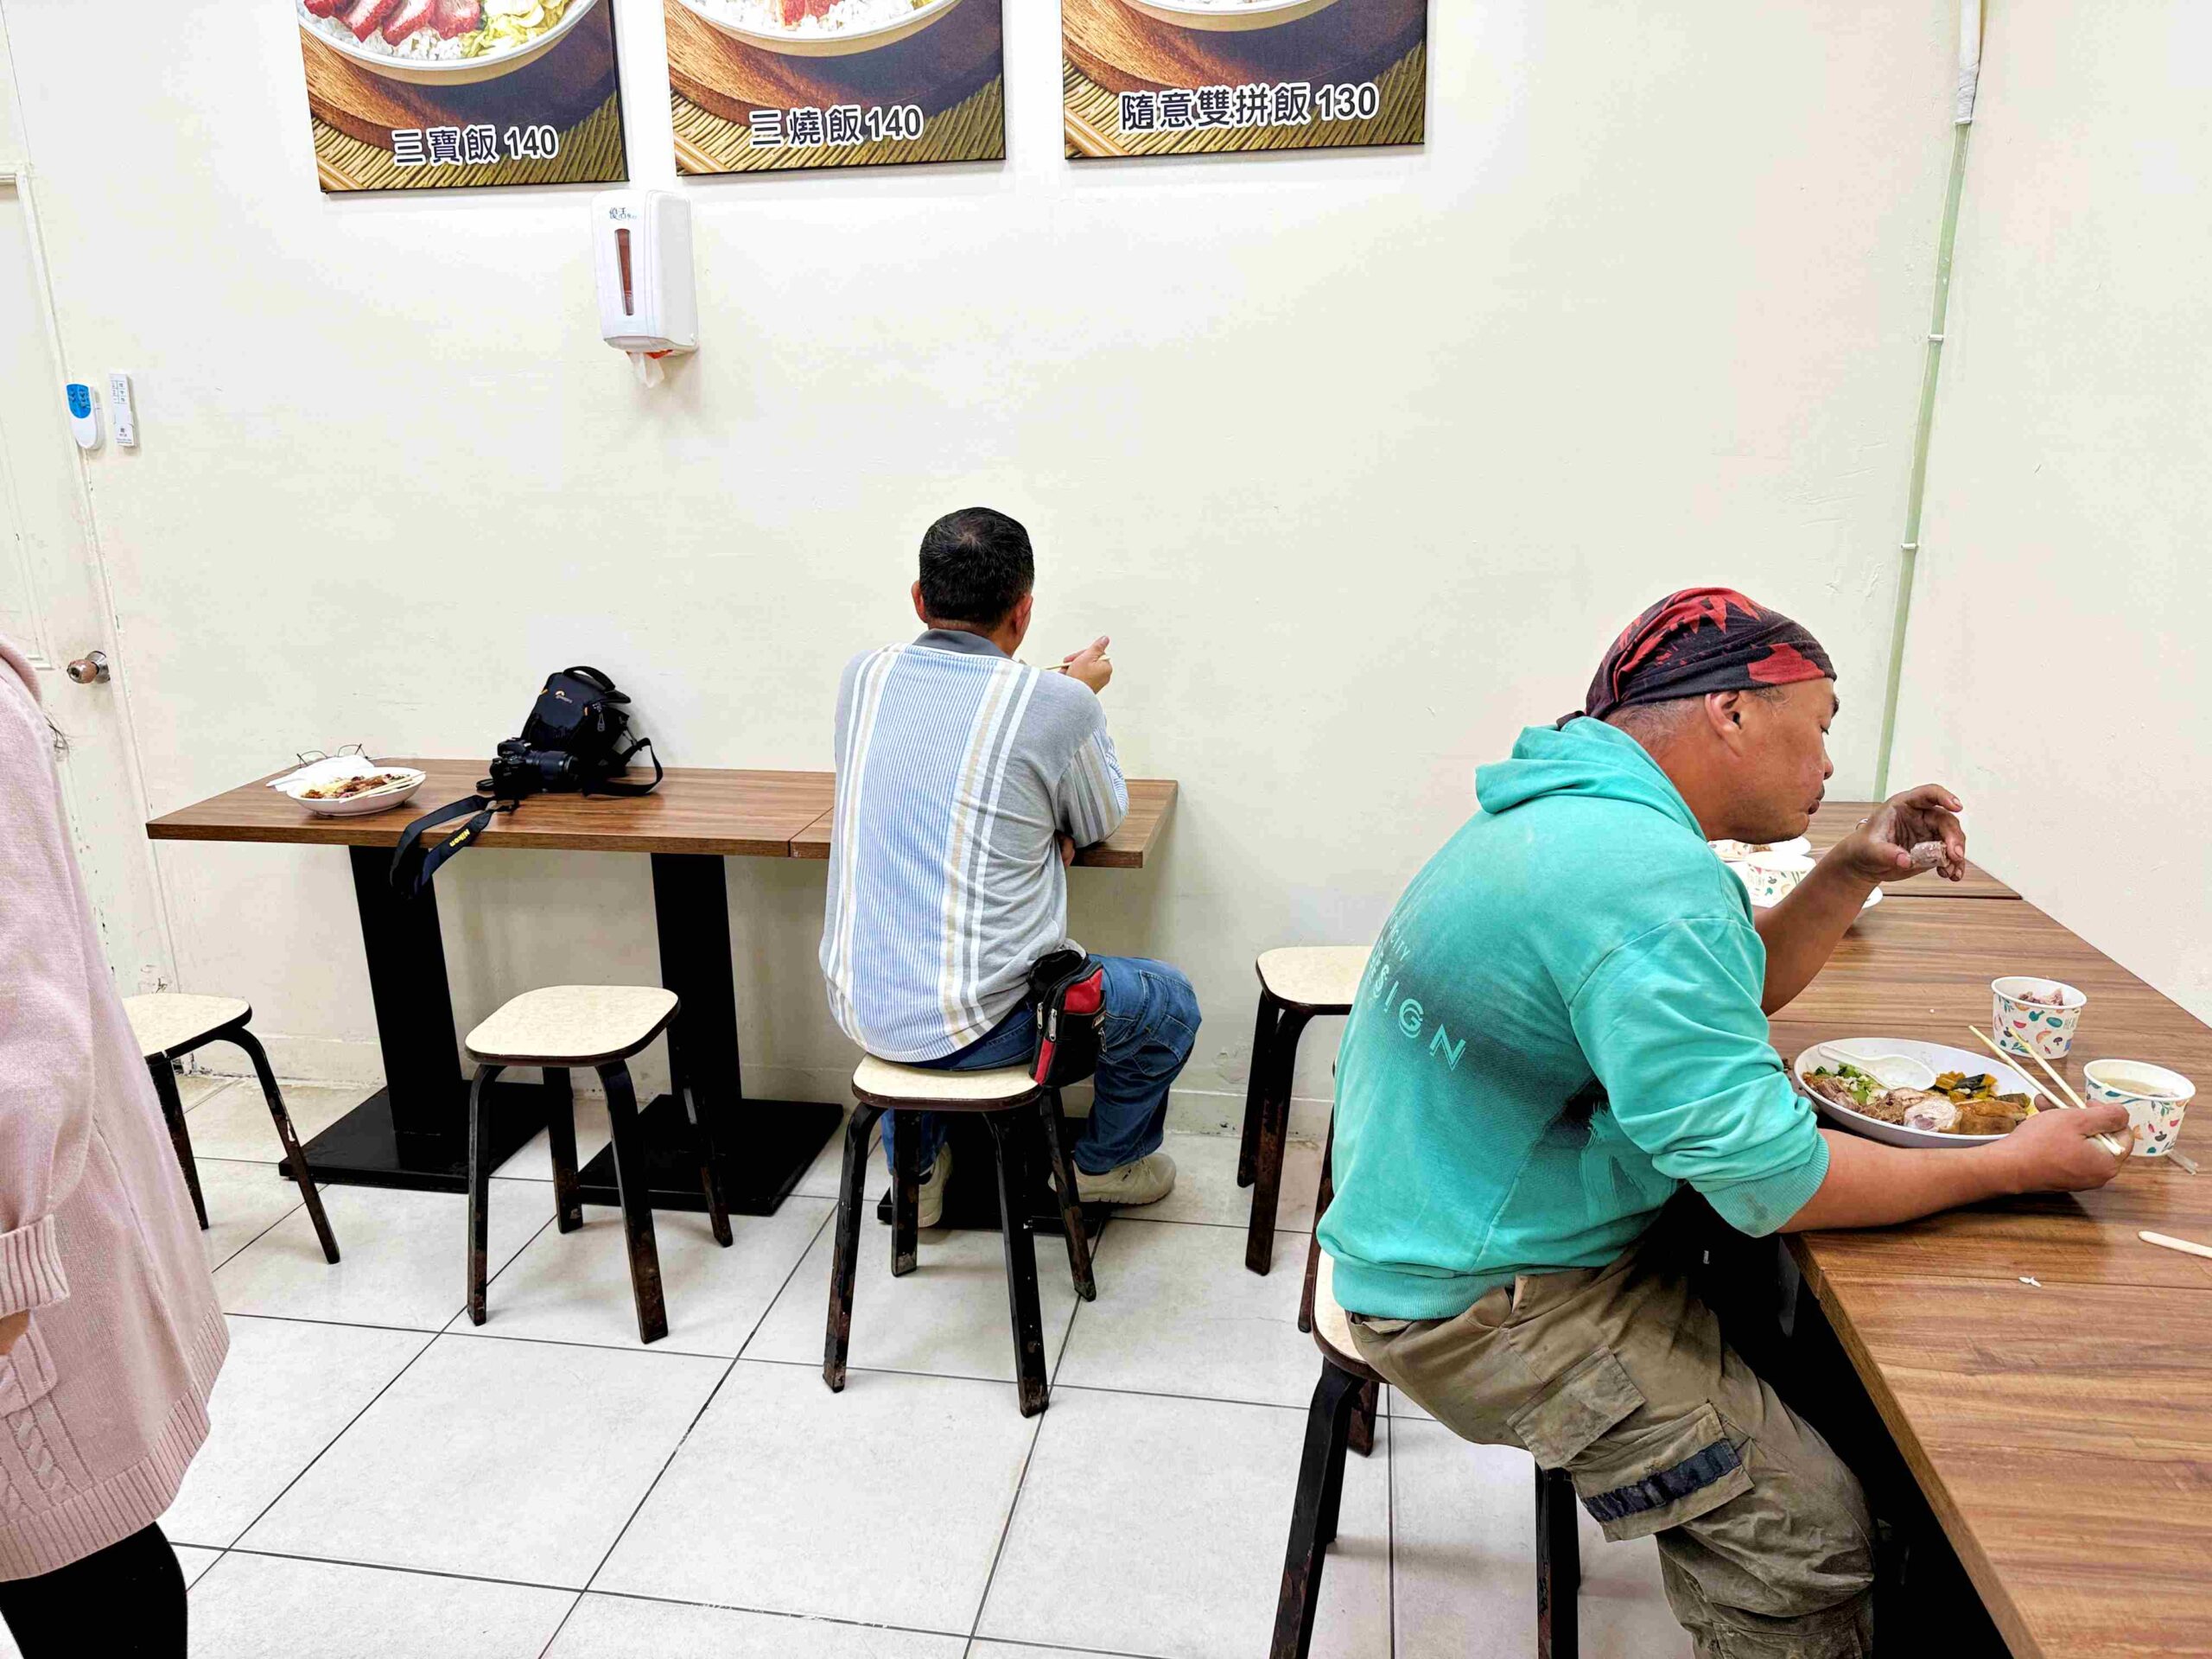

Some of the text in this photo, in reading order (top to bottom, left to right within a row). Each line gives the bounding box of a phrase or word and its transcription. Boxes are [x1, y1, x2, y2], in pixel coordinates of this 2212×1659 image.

[1317, 85, 1377, 118] 130
[393, 126, 557, 164] 三寶飯 140
[449, 829, 470, 847] Nikon
